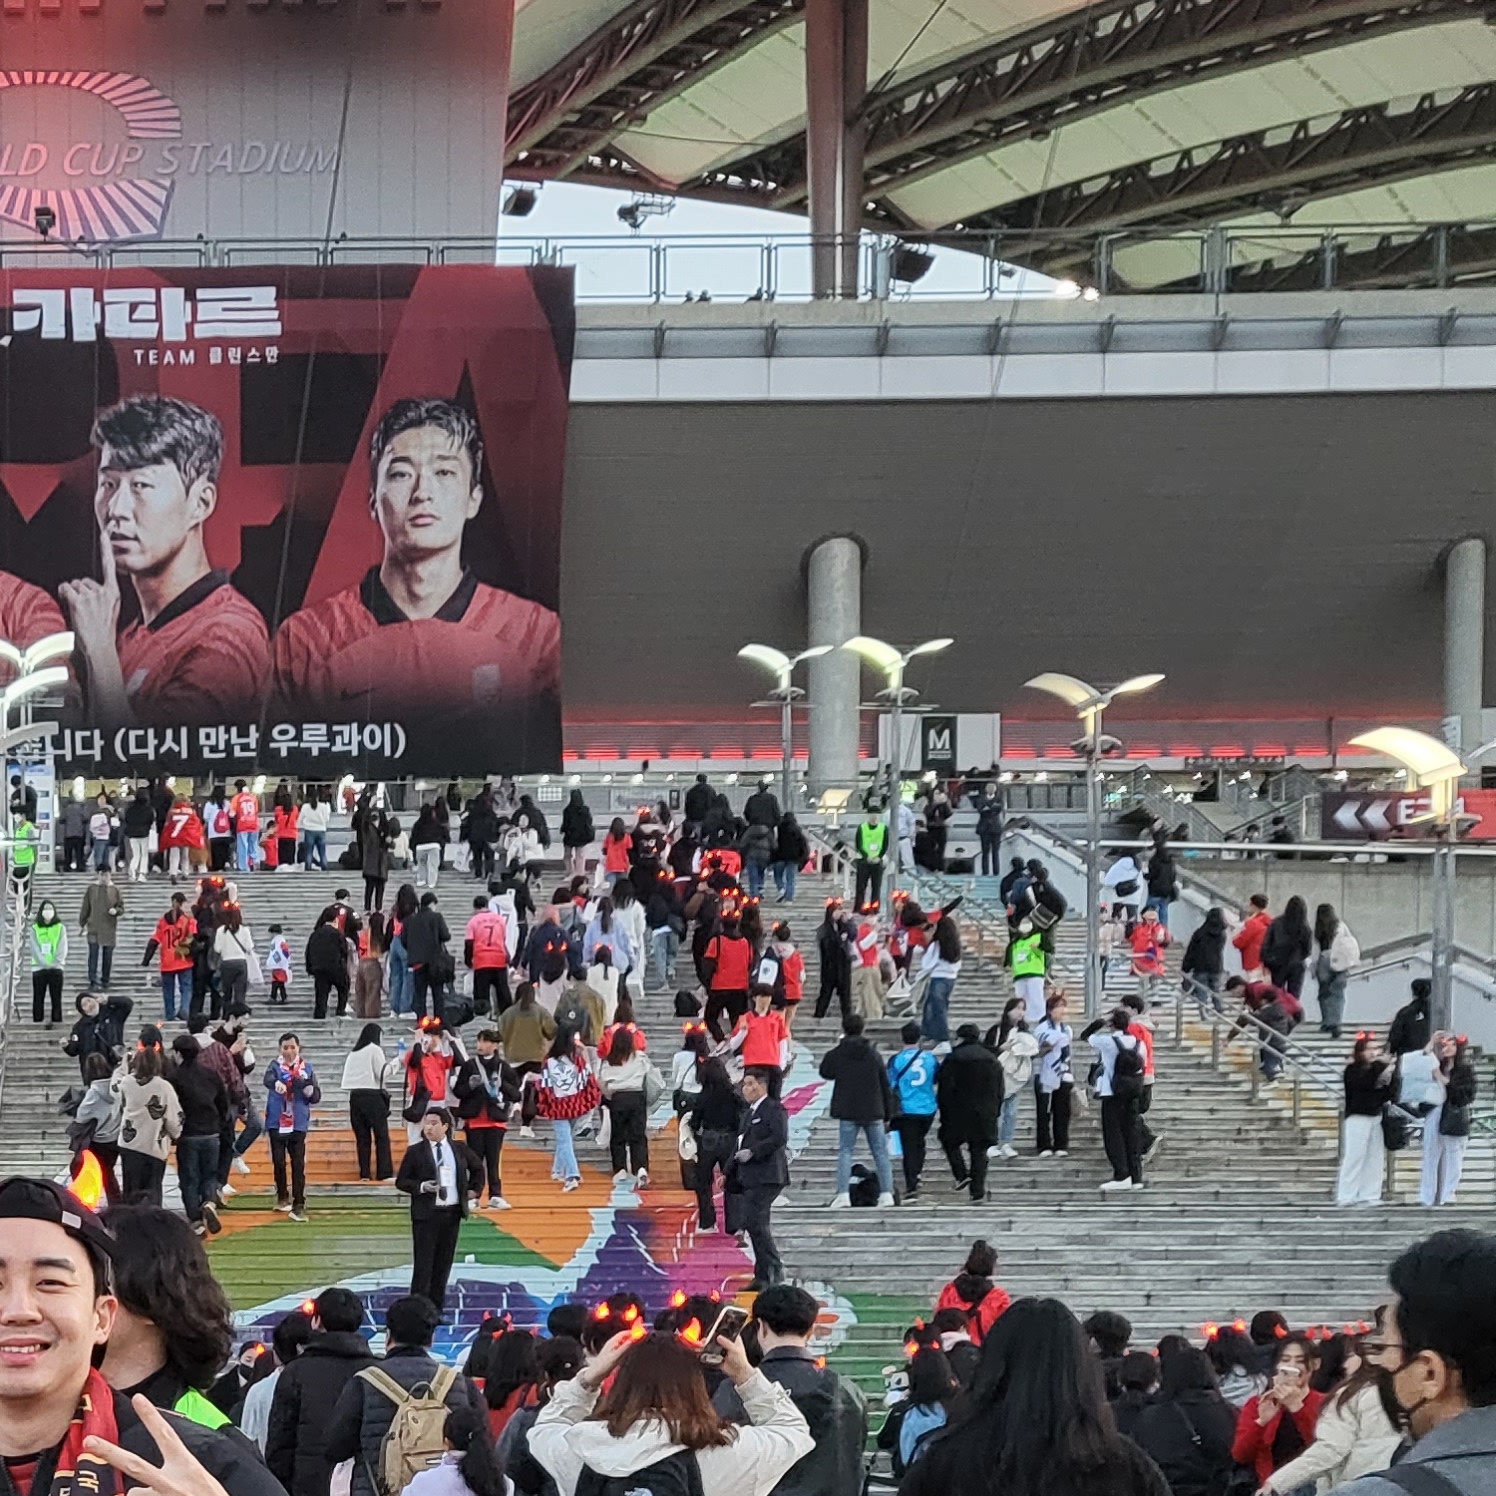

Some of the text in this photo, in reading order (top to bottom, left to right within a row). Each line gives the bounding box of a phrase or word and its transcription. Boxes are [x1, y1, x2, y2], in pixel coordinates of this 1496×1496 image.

[62, 142, 145, 177] CUP
[161, 140, 340, 176] STADIUM
[133, 348, 195, 367] TEAM
[113, 725, 189, 763] (다시
[198, 724, 260, 760] 만난
[268, 722, 407, 758] 우루과이)
[929, 728, 950, 750] M
[171, 814, 190, 839] 7
[483, 925, 494, 947] 7
[910, 1059, 927, 1087] 3
